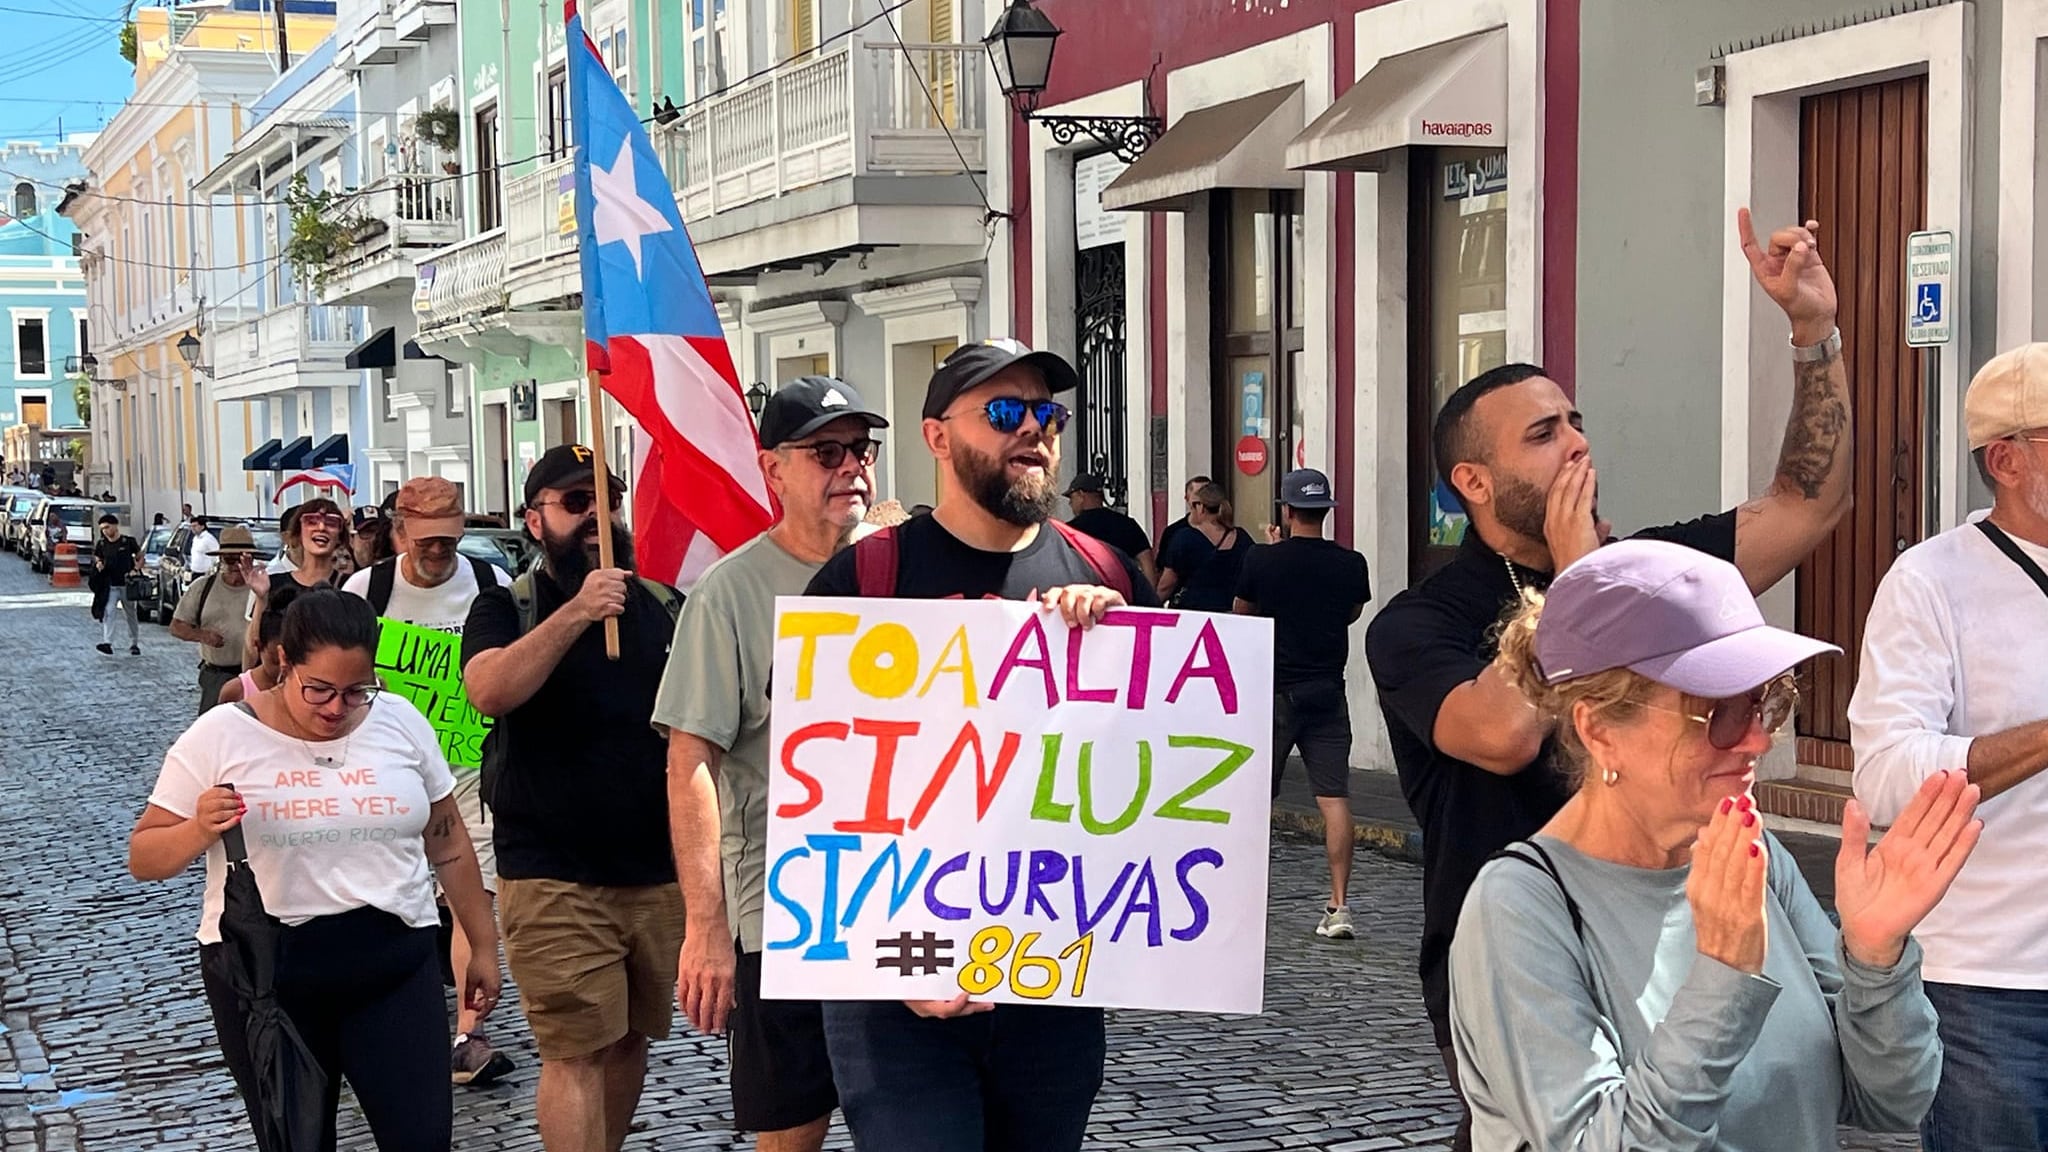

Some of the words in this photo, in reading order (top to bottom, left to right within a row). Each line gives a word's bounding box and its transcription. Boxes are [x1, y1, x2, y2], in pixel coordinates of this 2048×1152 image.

[1422, 119, 1493, 138] havaianas
[373, 622, 452, 681] LUMA
[778, 611, 980, 709] TOA
[988, 611, 1238, 714] ALTA
[274, 770, 322, 789] ARE
[338, 768, 377, 786] WE
[775, 717, 1022, 836] SIN
[1030, 731, 1255, 836] LUZ
[257, 798, 340, 822] THERE
[352, 797, 397, 815] YET
[259, 829, 341, 848] PUERTO
[350, 827, 397, 843] RICO
[766, 834, 932, 961] SIN
[923, 847, 1225, 948] CURVAS
[875, 925, 1094, 1000] #861
